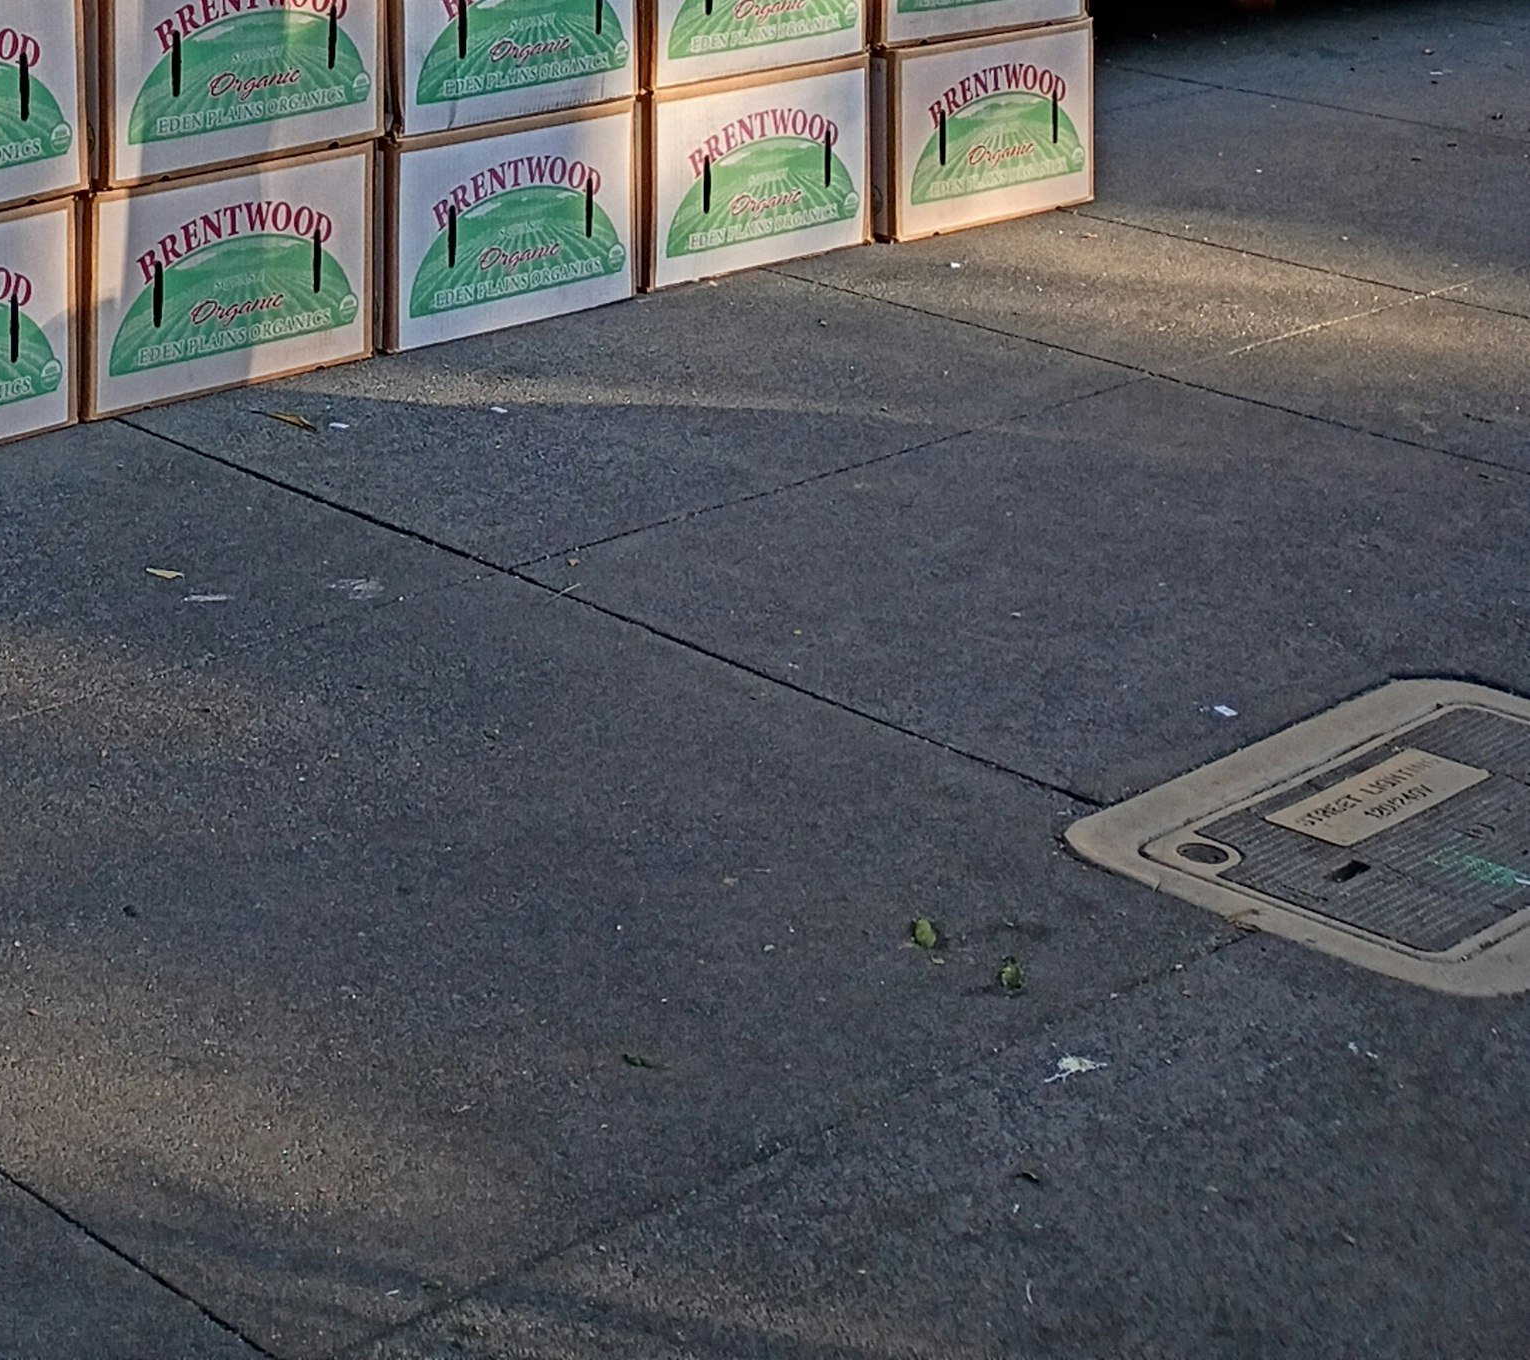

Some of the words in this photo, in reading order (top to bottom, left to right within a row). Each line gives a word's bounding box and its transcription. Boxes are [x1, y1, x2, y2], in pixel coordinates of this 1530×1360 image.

[490, 36, 572, 63] Organic
[210, 67, 302, 98] Organic
[929, 63, 1066, 130] BRENTWOOD
[157, 112, 202, 133] EDEN
[206, 101, 265, 128] PLAINS
[268, 86, 346, 117] ORGANICS
[688, 108, 839, 178] BRENTWOOD
[969, 141, 1034, 168] Organic
[432, 155, 601, 232] BRENTWOOD
[731, 188, 803, 217] Organic
[137, 201, 332, 286] BRENTWOOD
[479, 241, 561, 271] Organic
[191, 291, 285, 325] Organic
[138, 344, 183, 366] EDEN
[186, 327, 247, 358] PLAINS
[251, 309, 331, 341] ORGANICS
